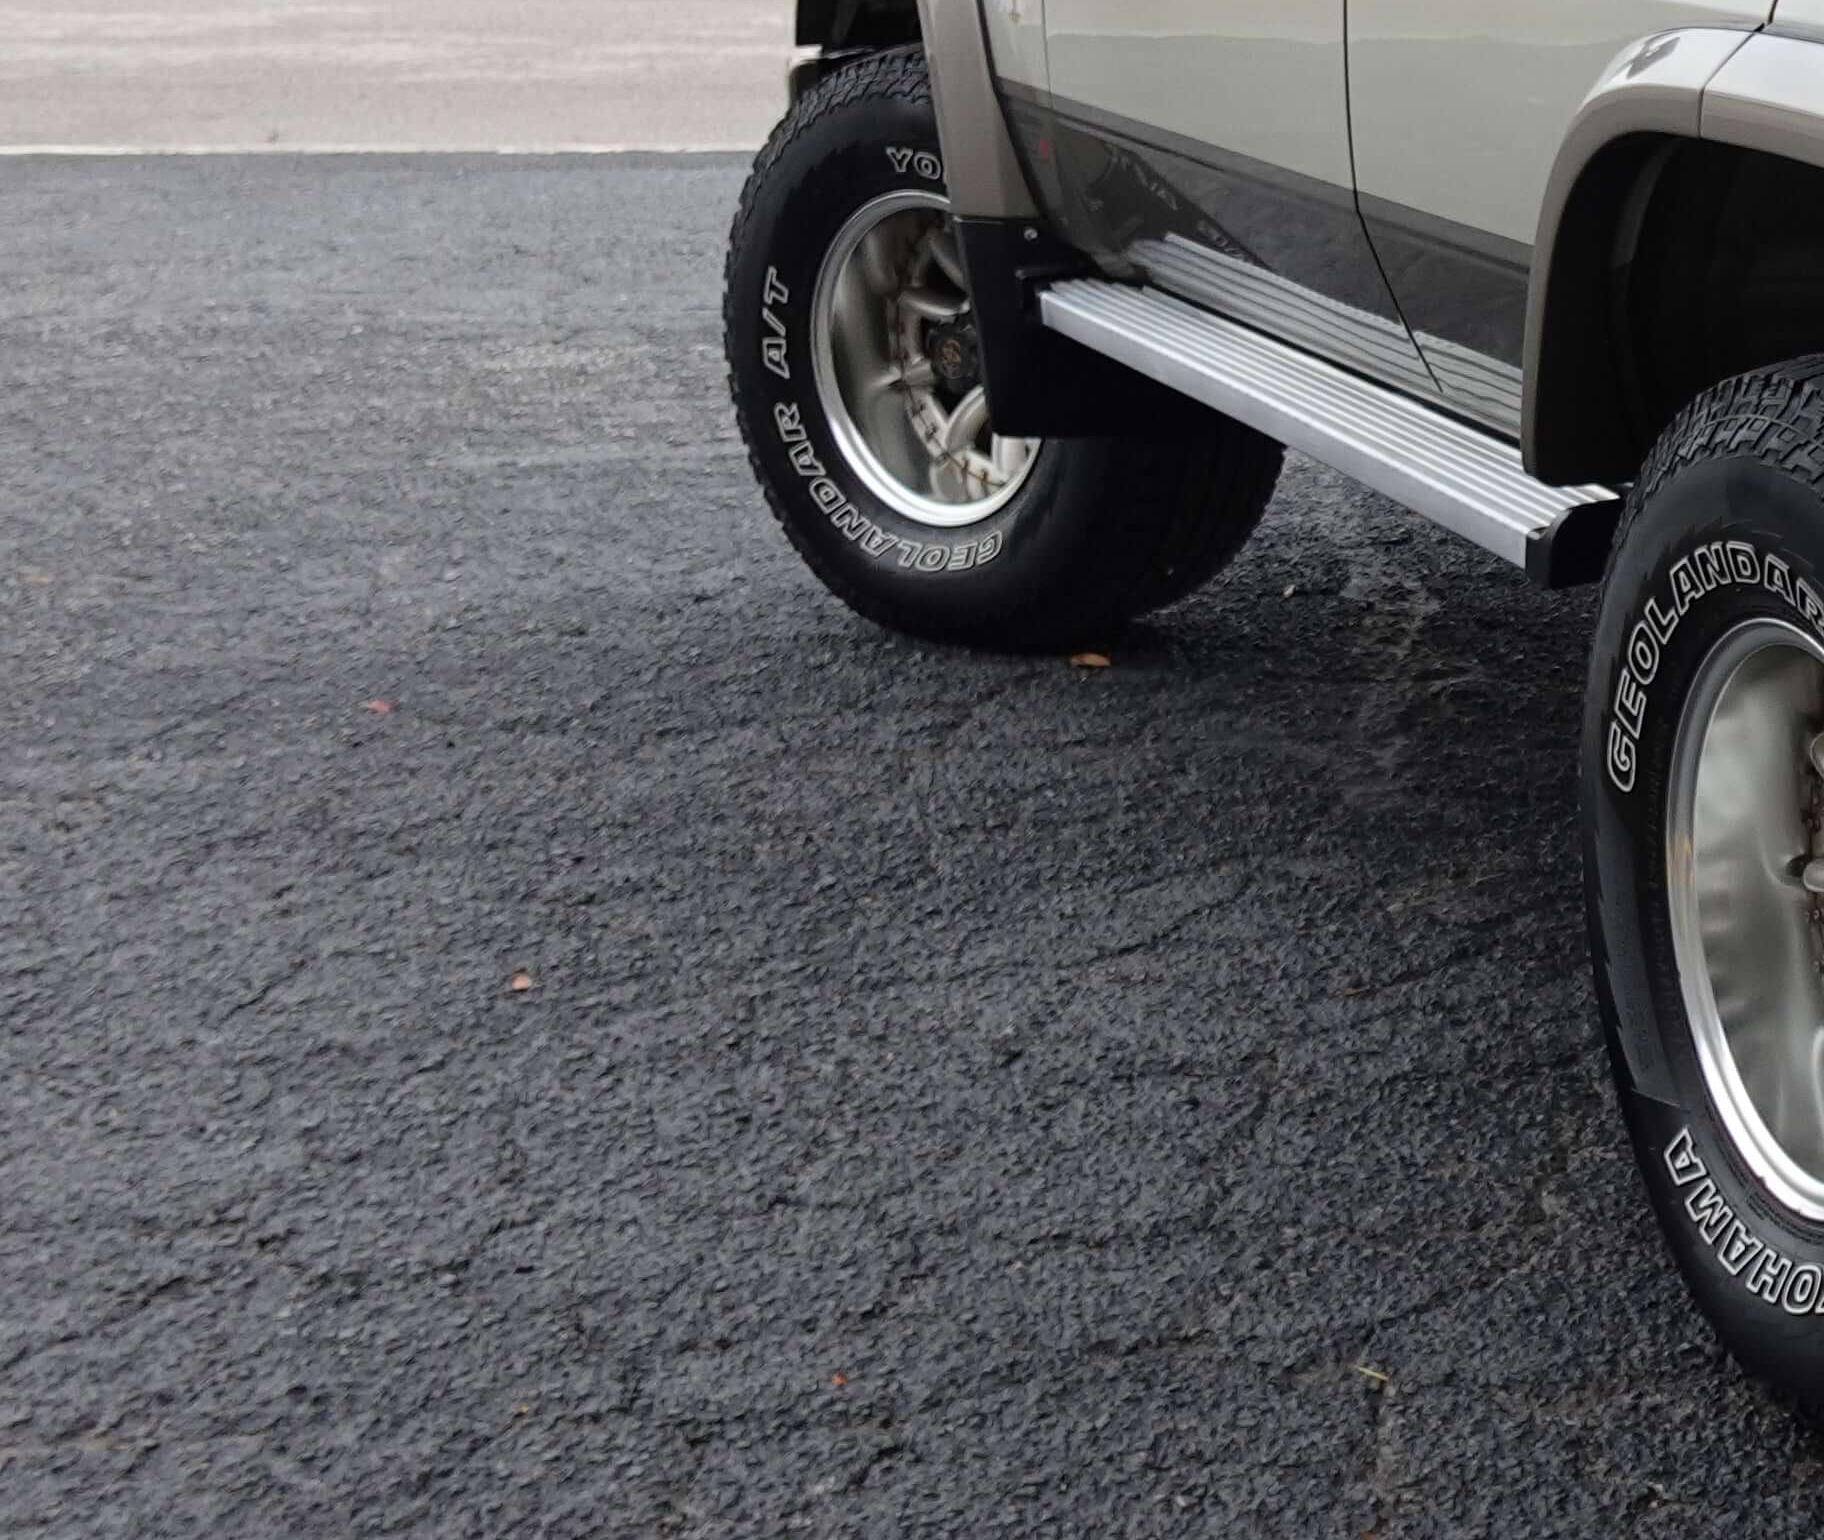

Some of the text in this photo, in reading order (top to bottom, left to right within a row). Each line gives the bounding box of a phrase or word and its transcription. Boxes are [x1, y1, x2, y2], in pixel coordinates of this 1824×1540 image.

[885, 146, 943, 180] YO
[762, 265, 1003, 572] GEOLANDAR A/T
